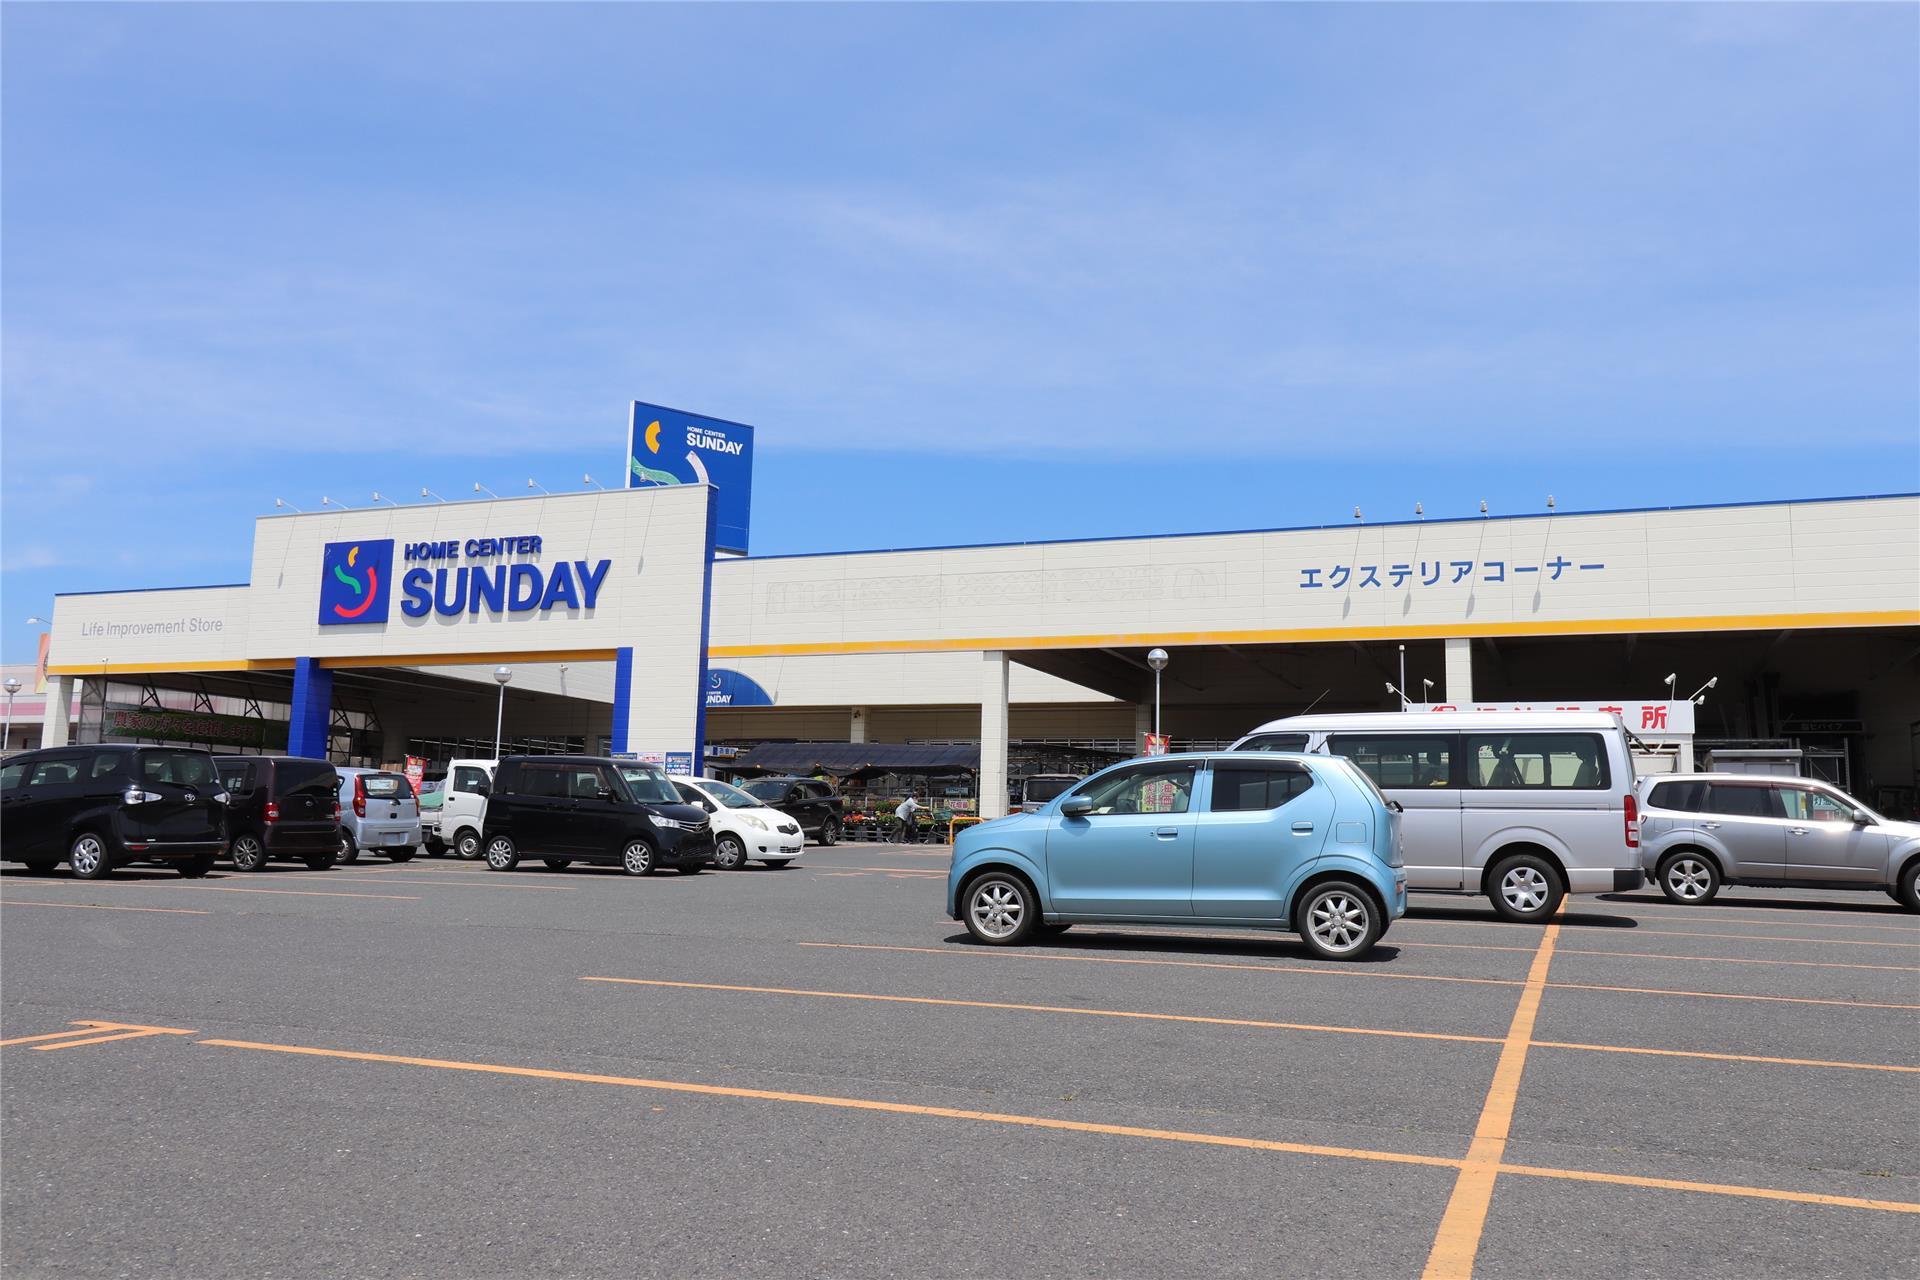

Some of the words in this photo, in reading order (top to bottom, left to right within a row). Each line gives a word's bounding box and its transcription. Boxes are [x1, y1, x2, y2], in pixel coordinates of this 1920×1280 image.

[686, 432, 743, 455] SUNDAY
[687, 426, 703, 434] HOME
[704, 430, 725, 438] CENTER
[404, 541, 459, 560] HOME
[465, 535, 543, 559] CENTER
[1300, 556, 1605, 589] エクステリアコーナー
[401, 560, 612, 618] SUNDAY
[81, 621, 105, 637] Life
[106, 618, 186, 638] Improvement
[189, 617, 223, 633] Store
[706, 695, 731, 704] UNDAY
